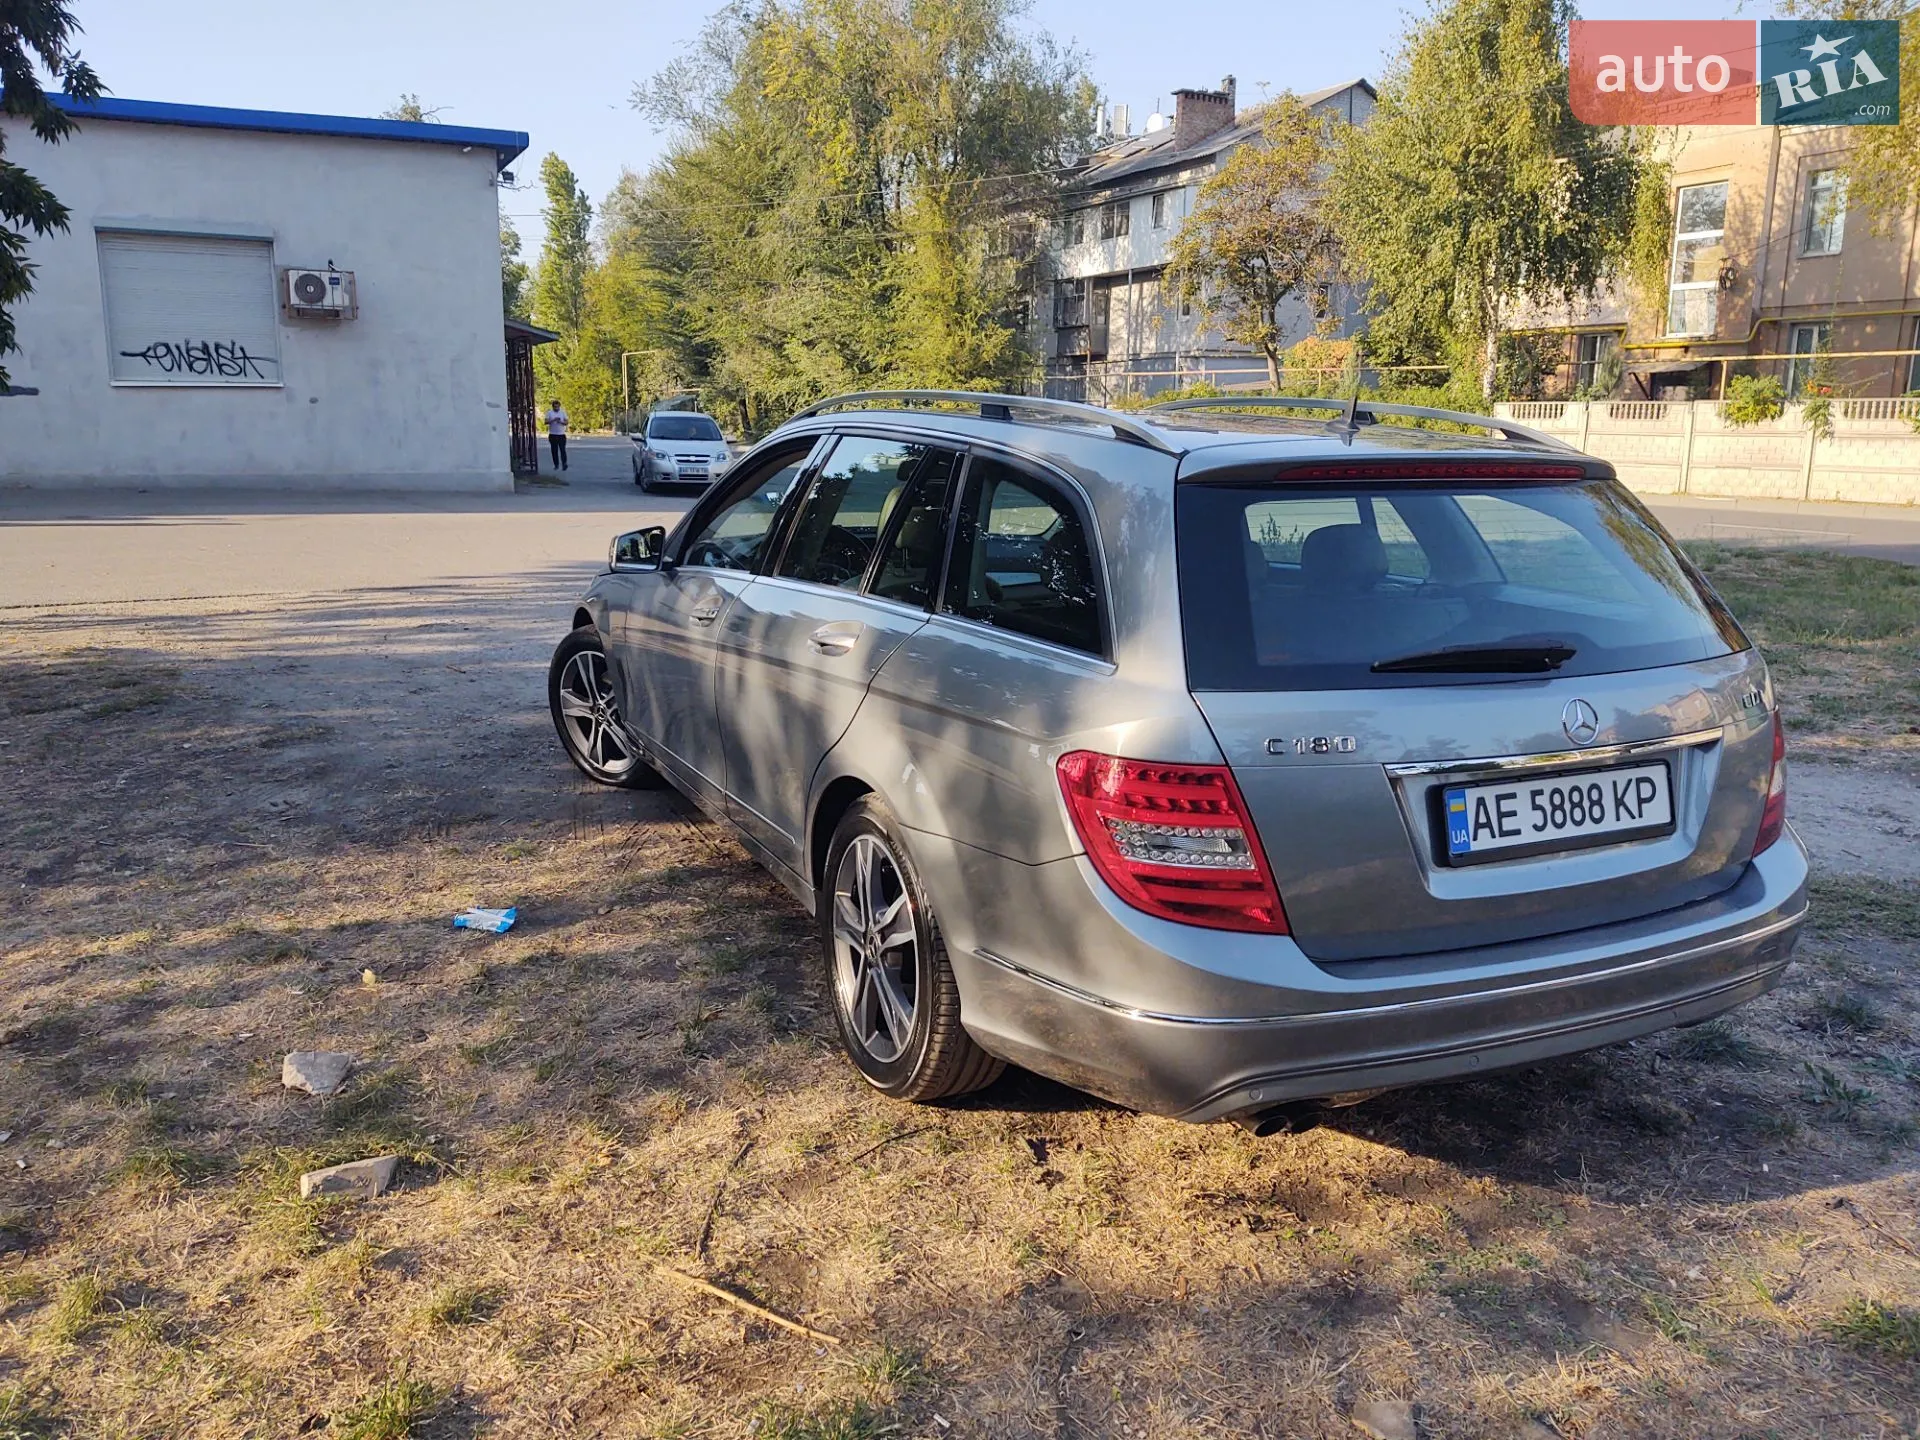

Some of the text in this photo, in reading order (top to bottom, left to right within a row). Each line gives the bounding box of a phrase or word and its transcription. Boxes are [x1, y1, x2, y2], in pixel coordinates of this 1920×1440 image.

[1263, 735, 1357, 755] C 180
[1472, 776, 1658, 842] AE 5888 KP
[1451, 829, 1469, 845] UA
